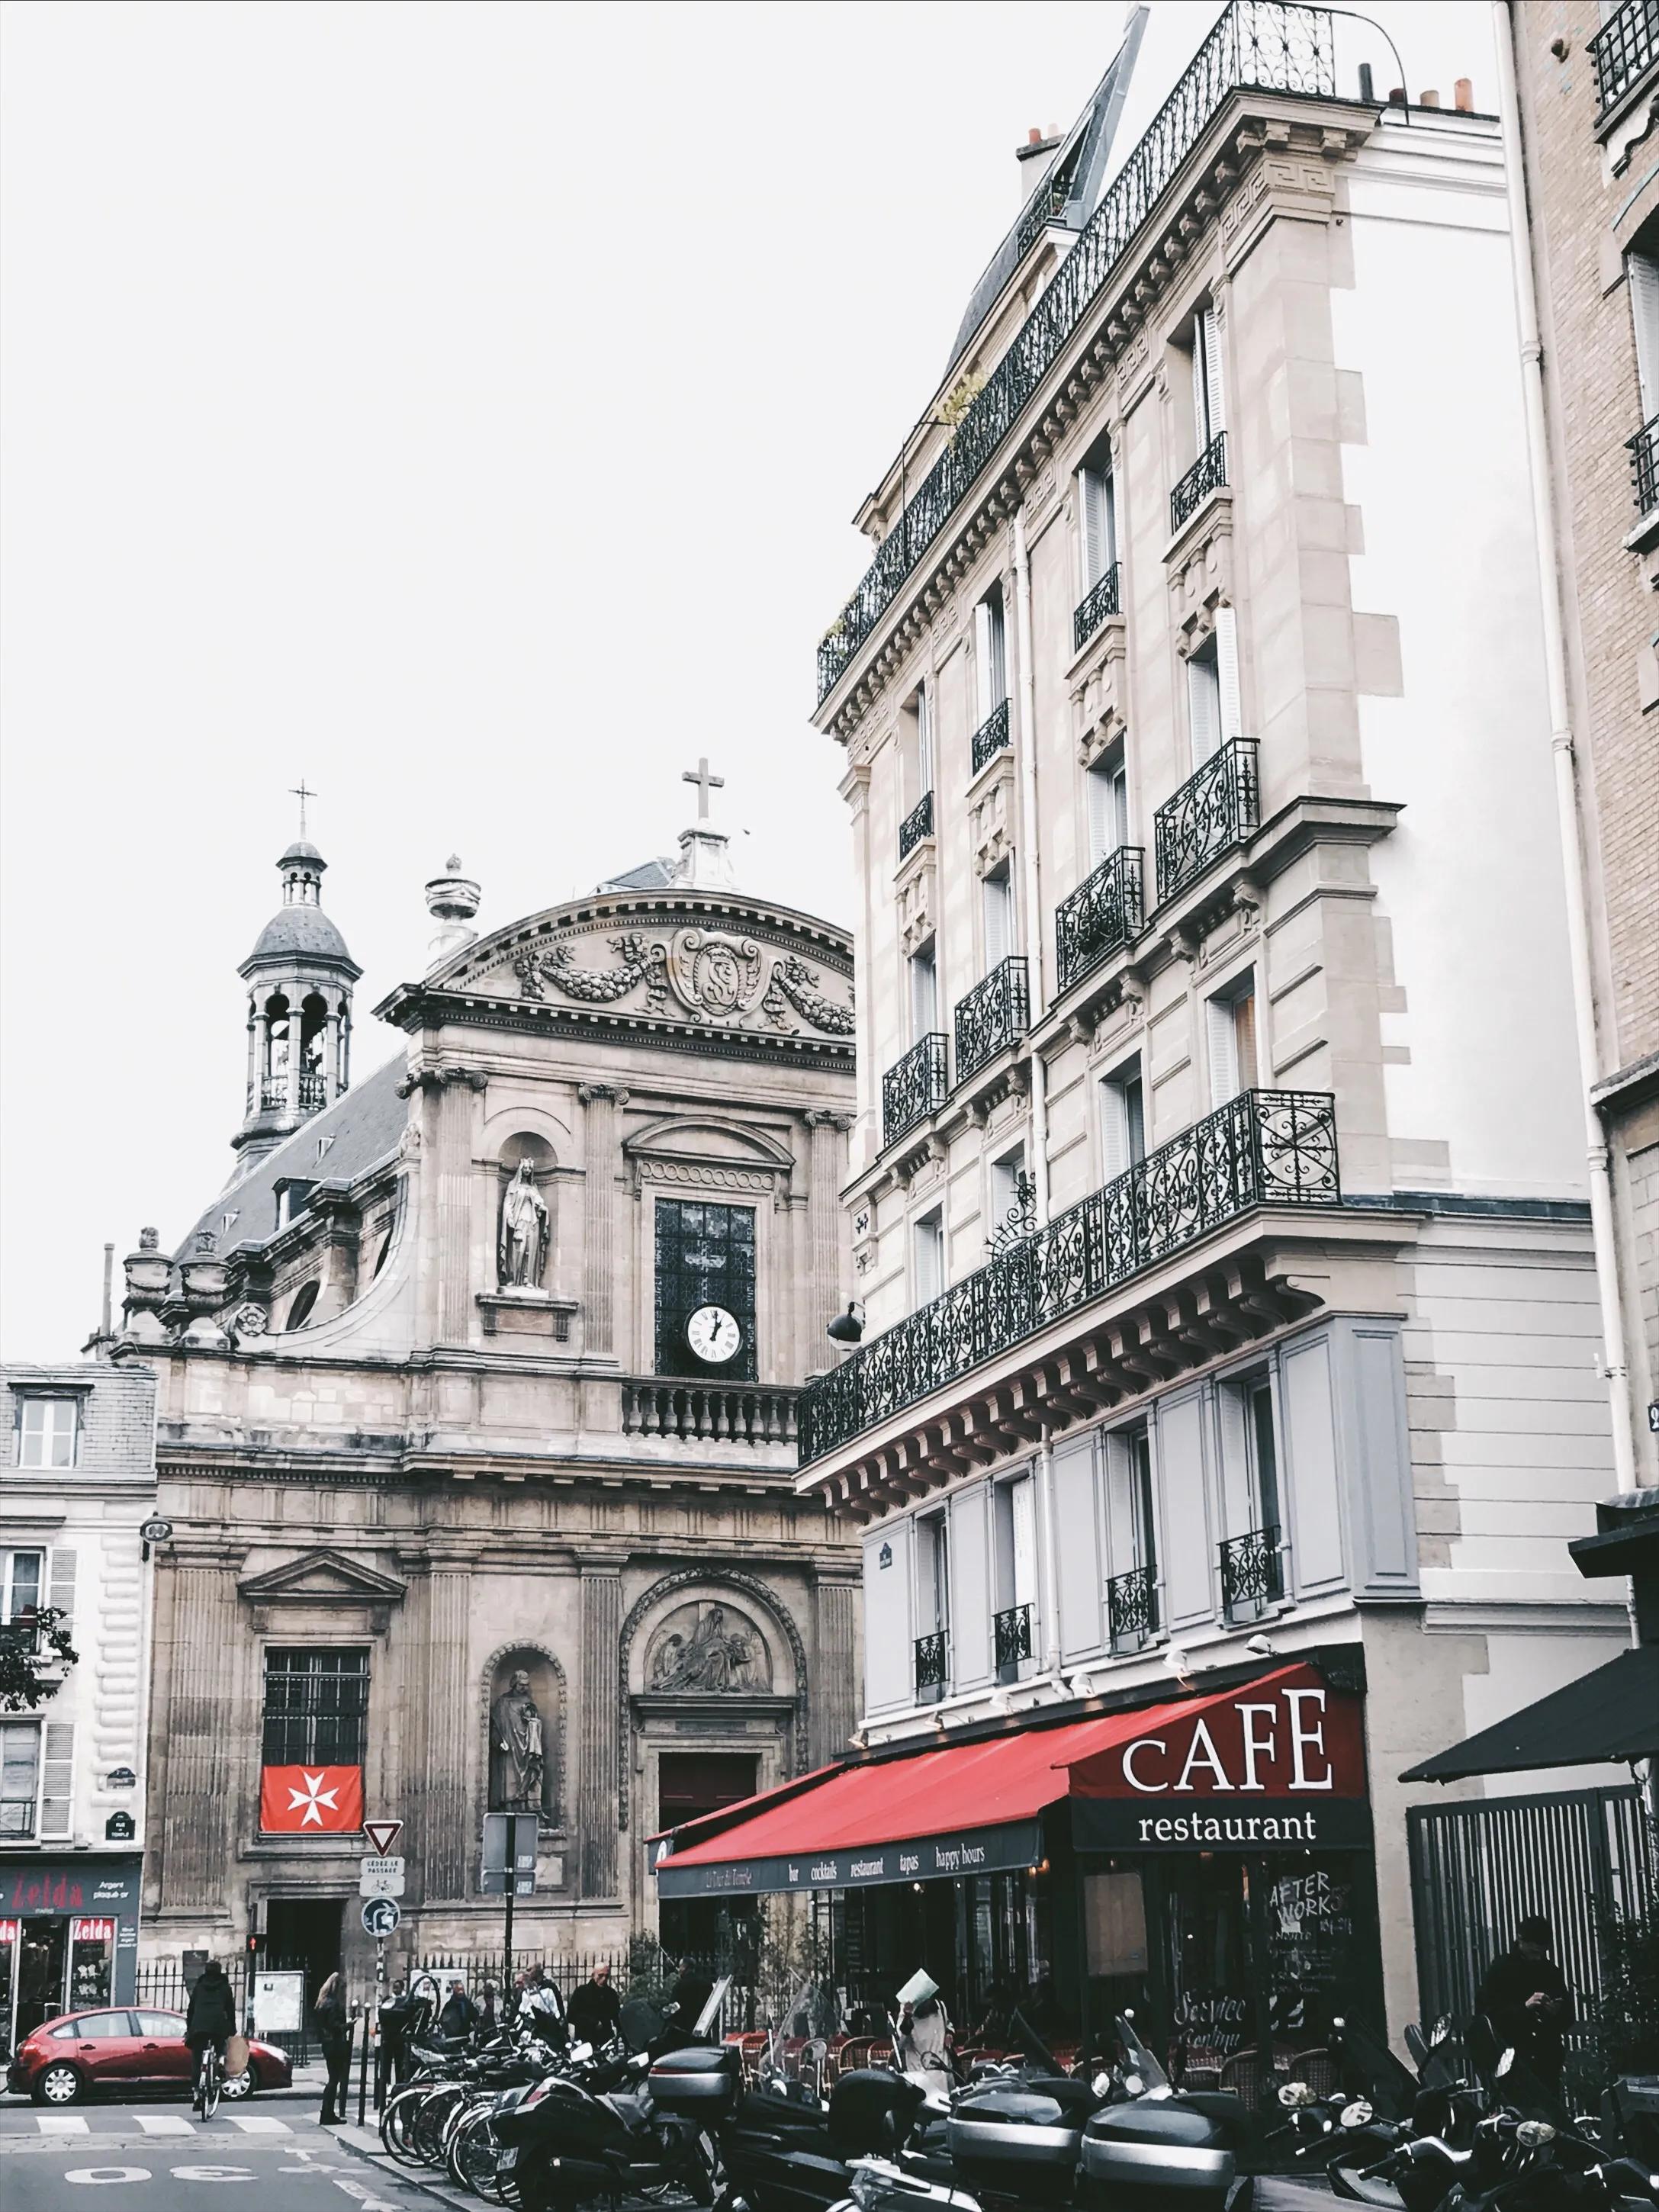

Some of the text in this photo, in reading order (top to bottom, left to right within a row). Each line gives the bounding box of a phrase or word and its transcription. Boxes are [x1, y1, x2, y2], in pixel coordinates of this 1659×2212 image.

[1122, 1687, 1333, 1792] CAFE
[1138, 1812, 1317, 1842] restaurant
[850, 1857, 884, 1878] restaurant
[899, 1854, 919, 1876] tapas
[935, 1843, 985, 1870] happy hours
[788, 1863, 799, 1882] bar
[810, 1860, 838, 1881] cocktails
[11, 1872, 83, 1910] Zelda
[1269, 1870, 1330, 1908] AFTER
[1277, 1895, 1331, 1927] WORK
[73, 1918, 113, 1940] Zelda
